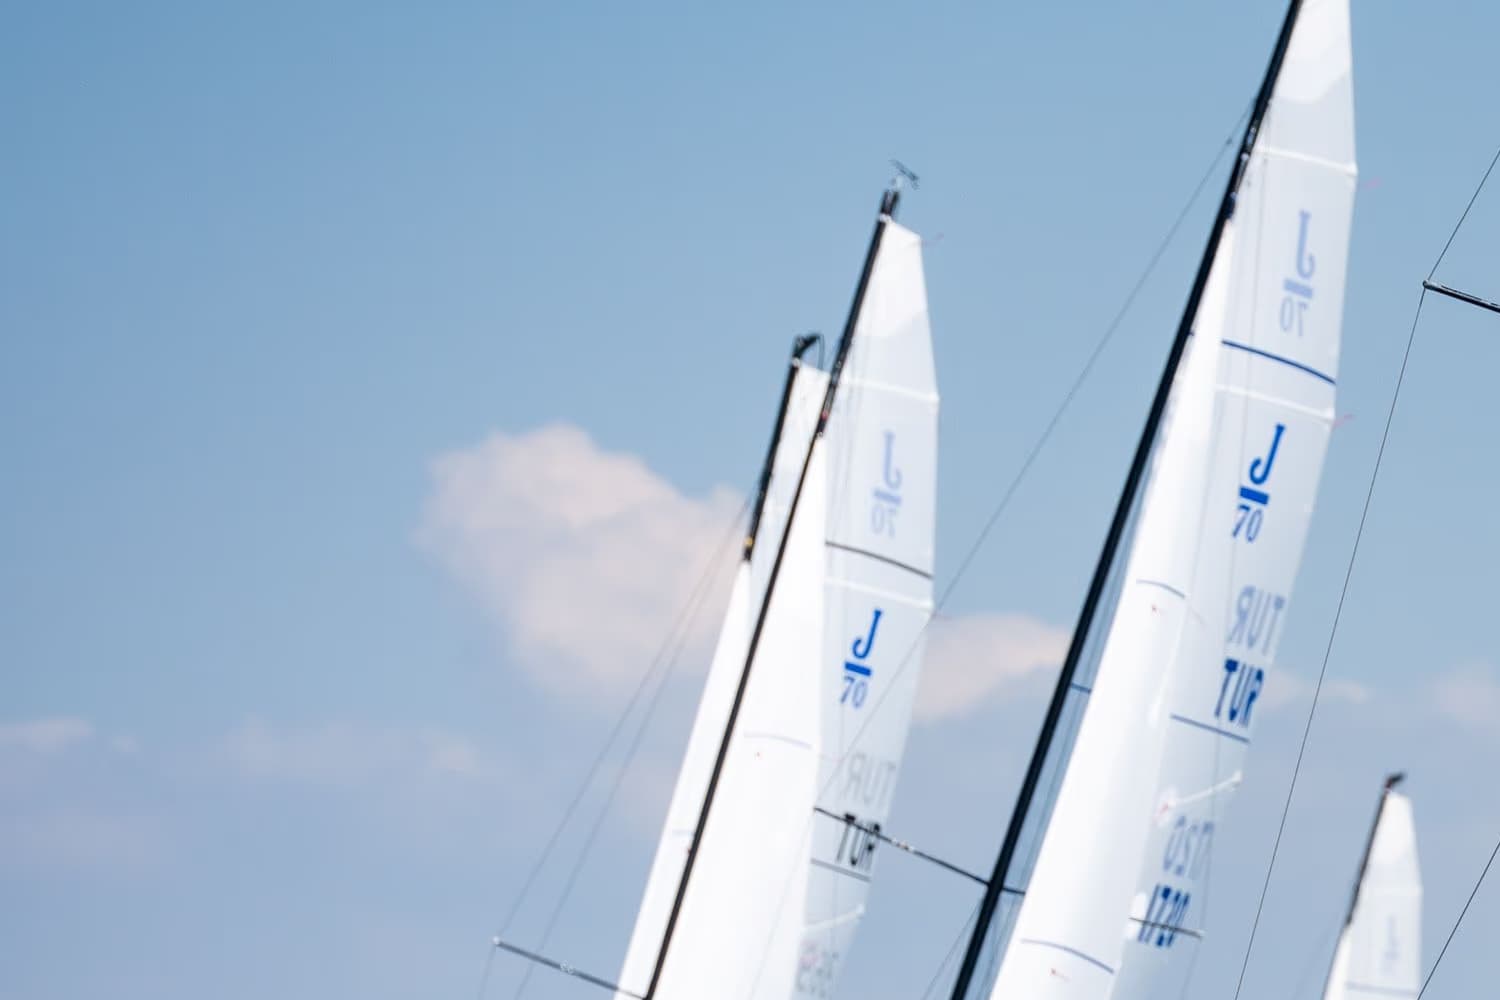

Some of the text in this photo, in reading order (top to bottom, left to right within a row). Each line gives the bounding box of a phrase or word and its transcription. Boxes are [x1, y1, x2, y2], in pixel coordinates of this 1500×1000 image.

[1249, 423, 1286, 486] J
[1232, 503, 1265, 543] 70
[852, 609, 884, 660] J
[840, 675, 869, 710] 70
[1214, 656, 1265, 728] TUR
